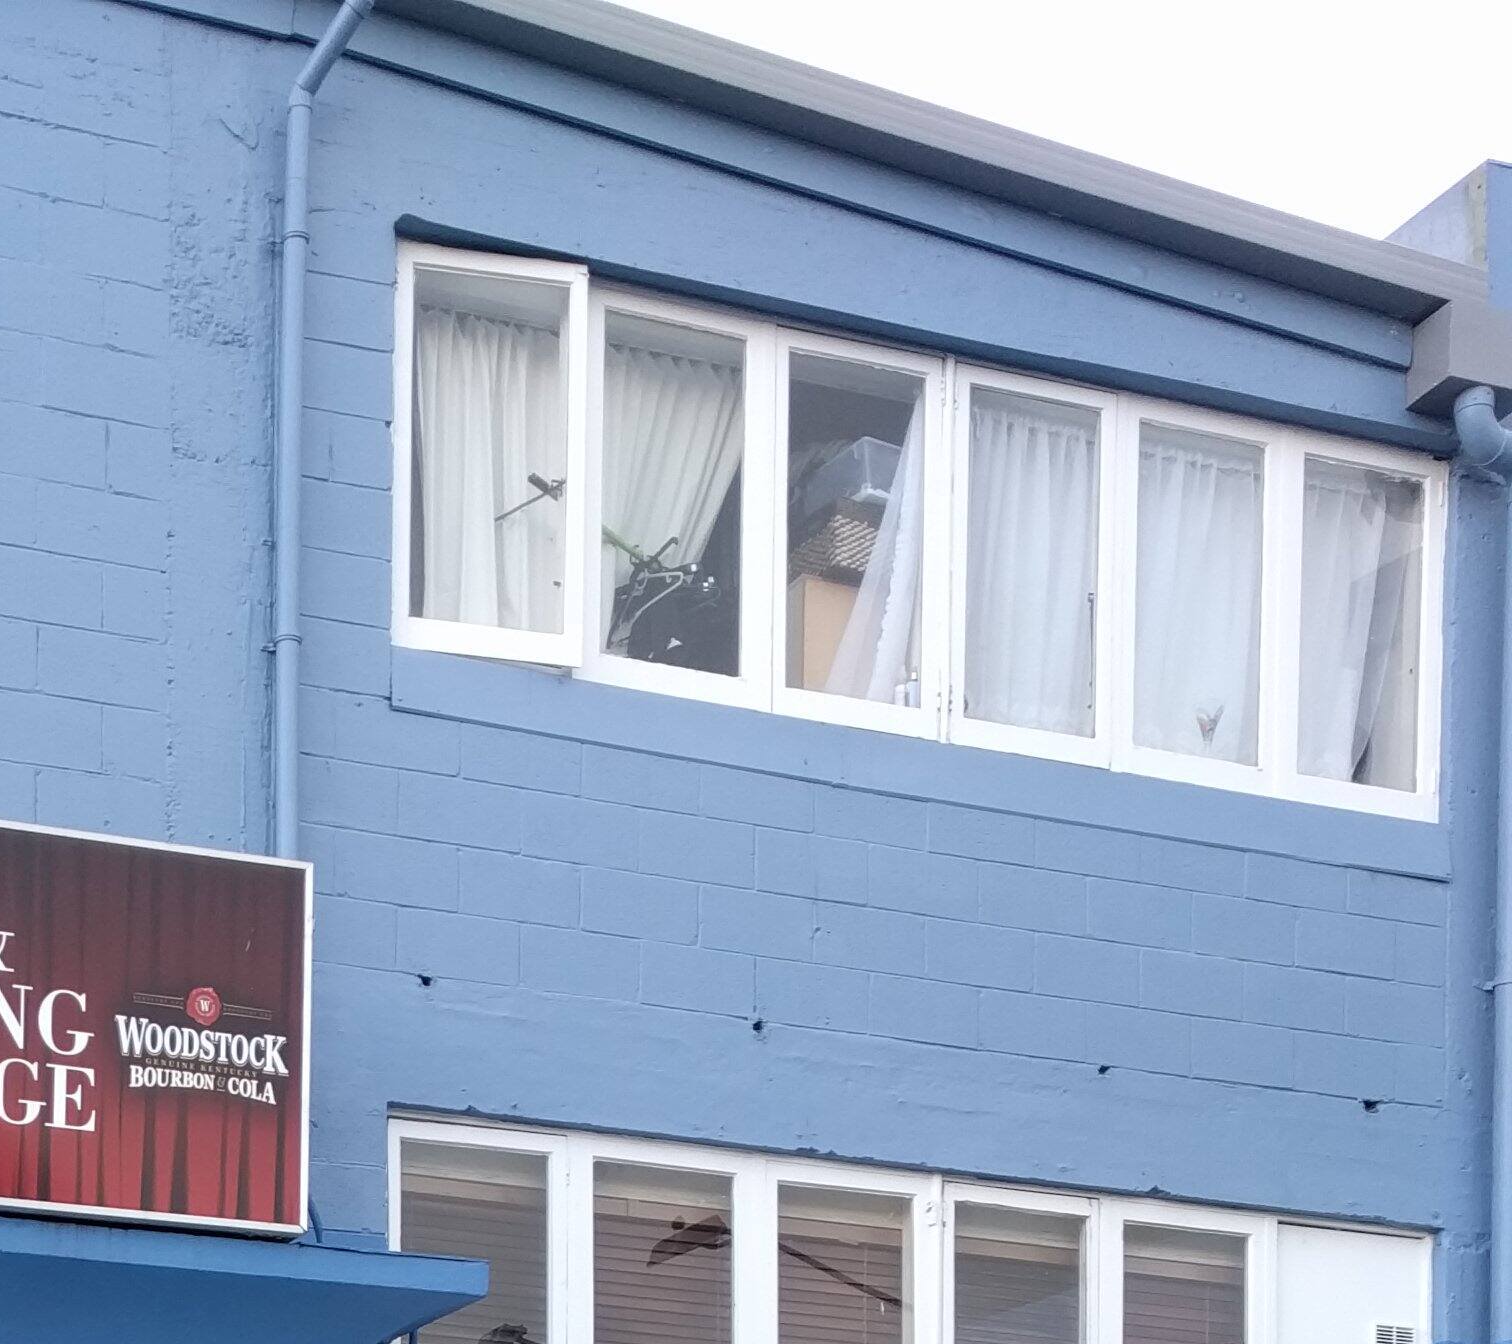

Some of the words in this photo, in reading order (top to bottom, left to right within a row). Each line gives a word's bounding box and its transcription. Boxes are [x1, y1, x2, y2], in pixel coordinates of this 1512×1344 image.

[114, 1014, 289, 1076] WOODSTOCK
[129, 1065, 215, 1091] BOURBON
[227, 1078, 277, 1105] COLA
